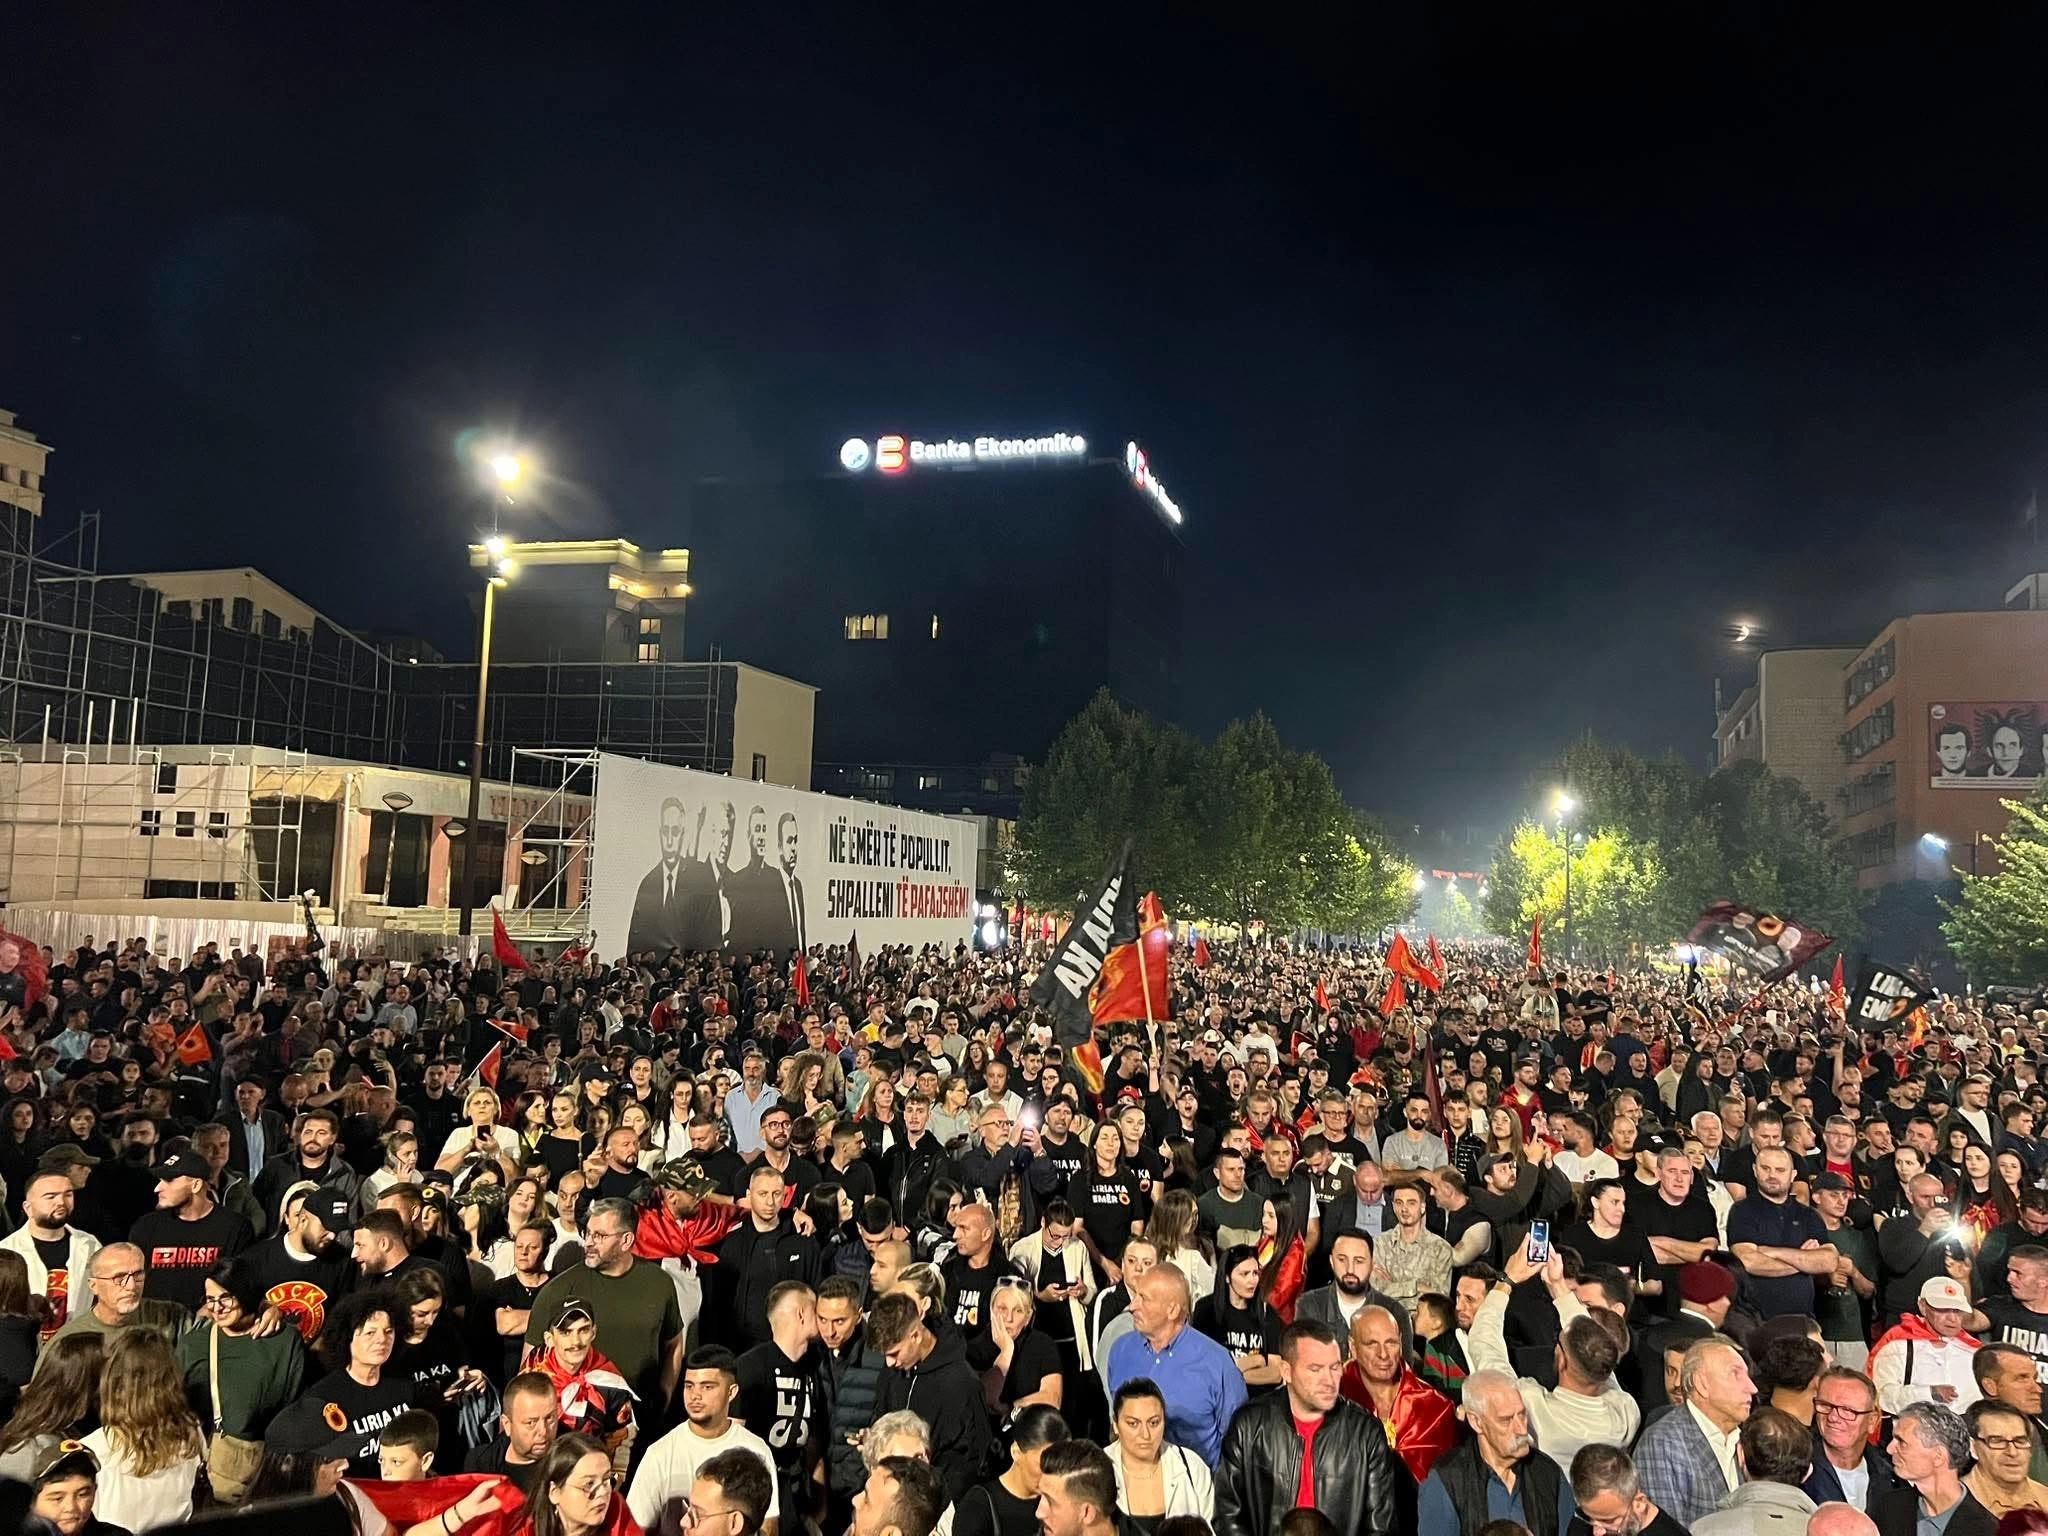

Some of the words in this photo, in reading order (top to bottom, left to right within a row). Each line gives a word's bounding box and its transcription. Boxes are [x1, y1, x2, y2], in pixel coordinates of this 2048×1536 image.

[910, 439, 971, 460] Banka
[829, 815, 847, 863] NË
[848, 820, 881, 867] EMËR
[883, 824, 897, 868] TË
[901, 834, 951, 875] POPULLIT,
[827, 879, 894, 918] SHPALLENI
[896, 876, 909, 919] TË
[910, 880, 969, 919] PAFAJSHËM!
[1092, 1184, 1115, 1194] LIRIA
[430, 1363, 452, 1377] KA
[352, 1409, 393, 1435] LIRIA
